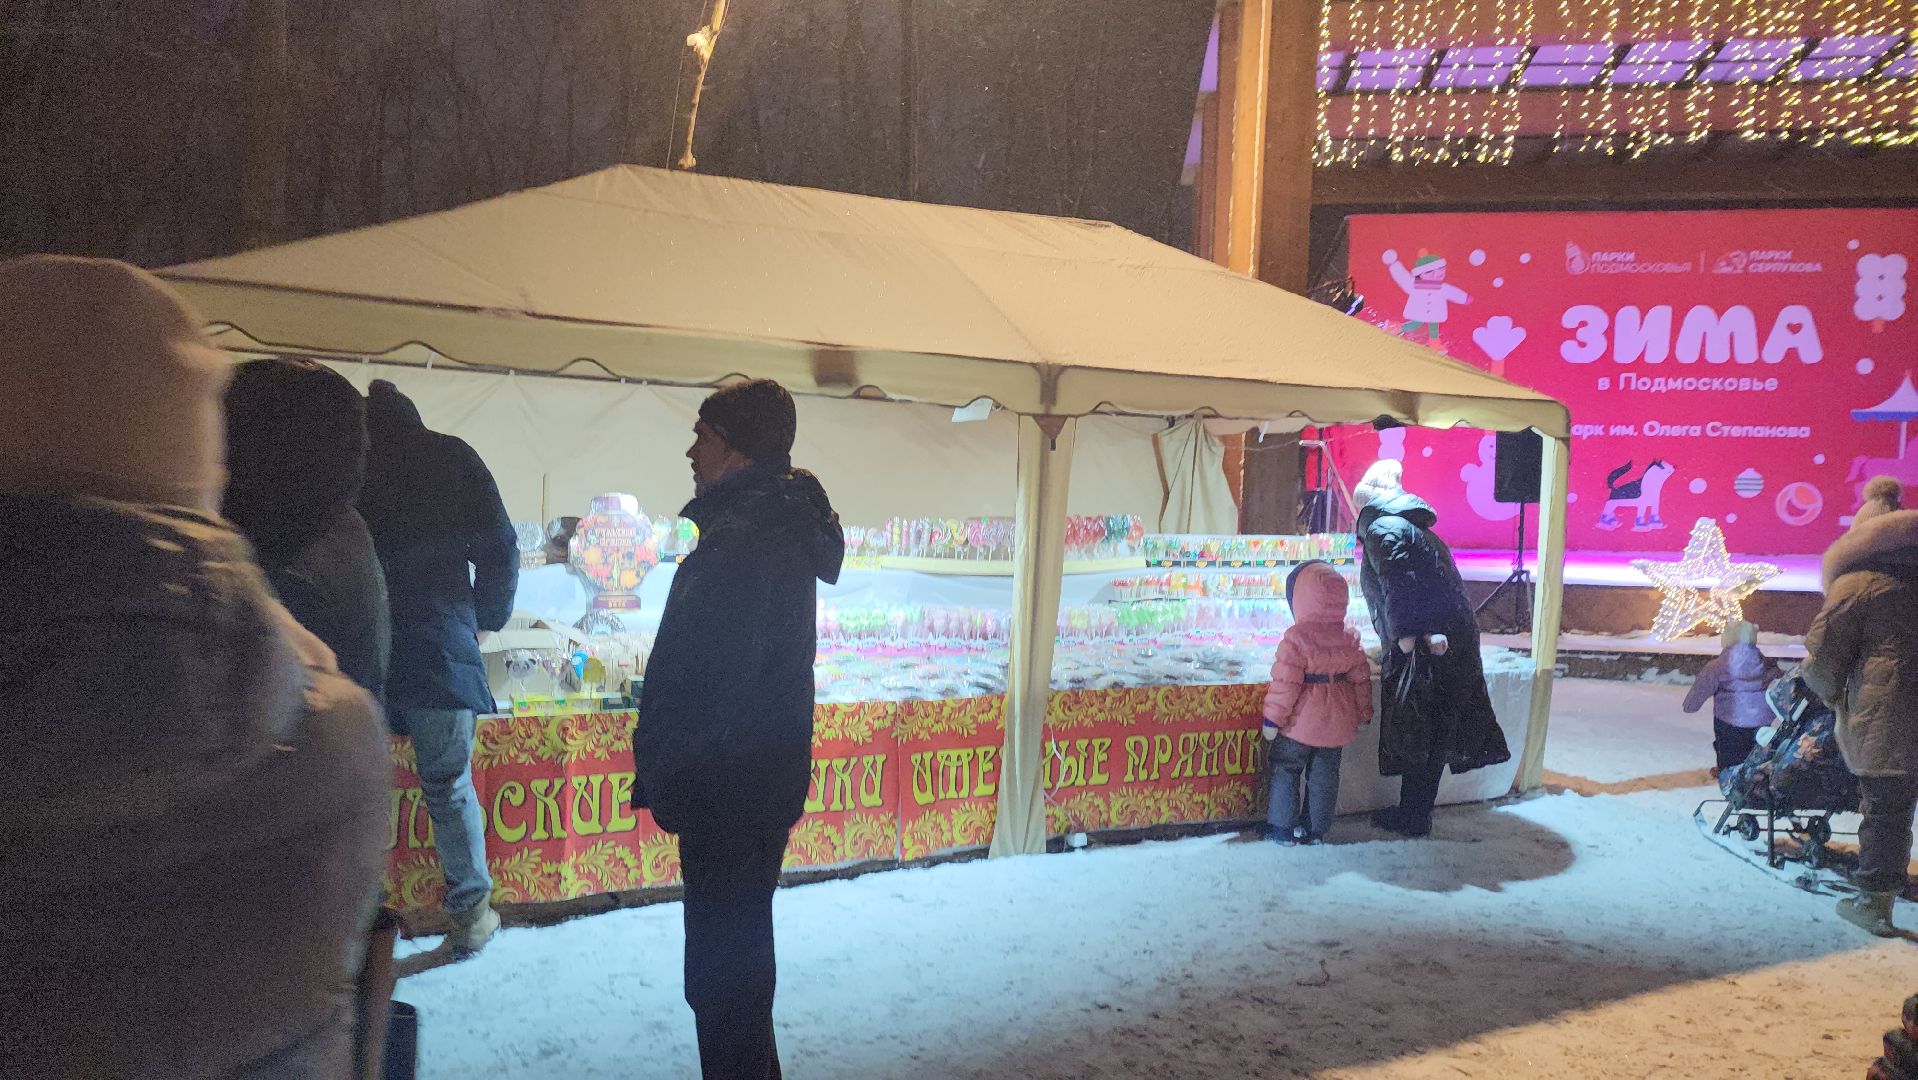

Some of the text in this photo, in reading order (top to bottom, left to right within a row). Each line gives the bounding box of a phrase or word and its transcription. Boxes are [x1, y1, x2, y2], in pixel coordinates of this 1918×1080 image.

[1591, 251, 1636, 262] ПАРКИ
[1560, 304, 1824, 364] ЗИМА
[1597, 372, 1779, 393] в Подмосковье
[1571, 420, 1811, 440] арк им. Олега Степанова
[1123, 729, 1263, 784] ПРЯНИК
